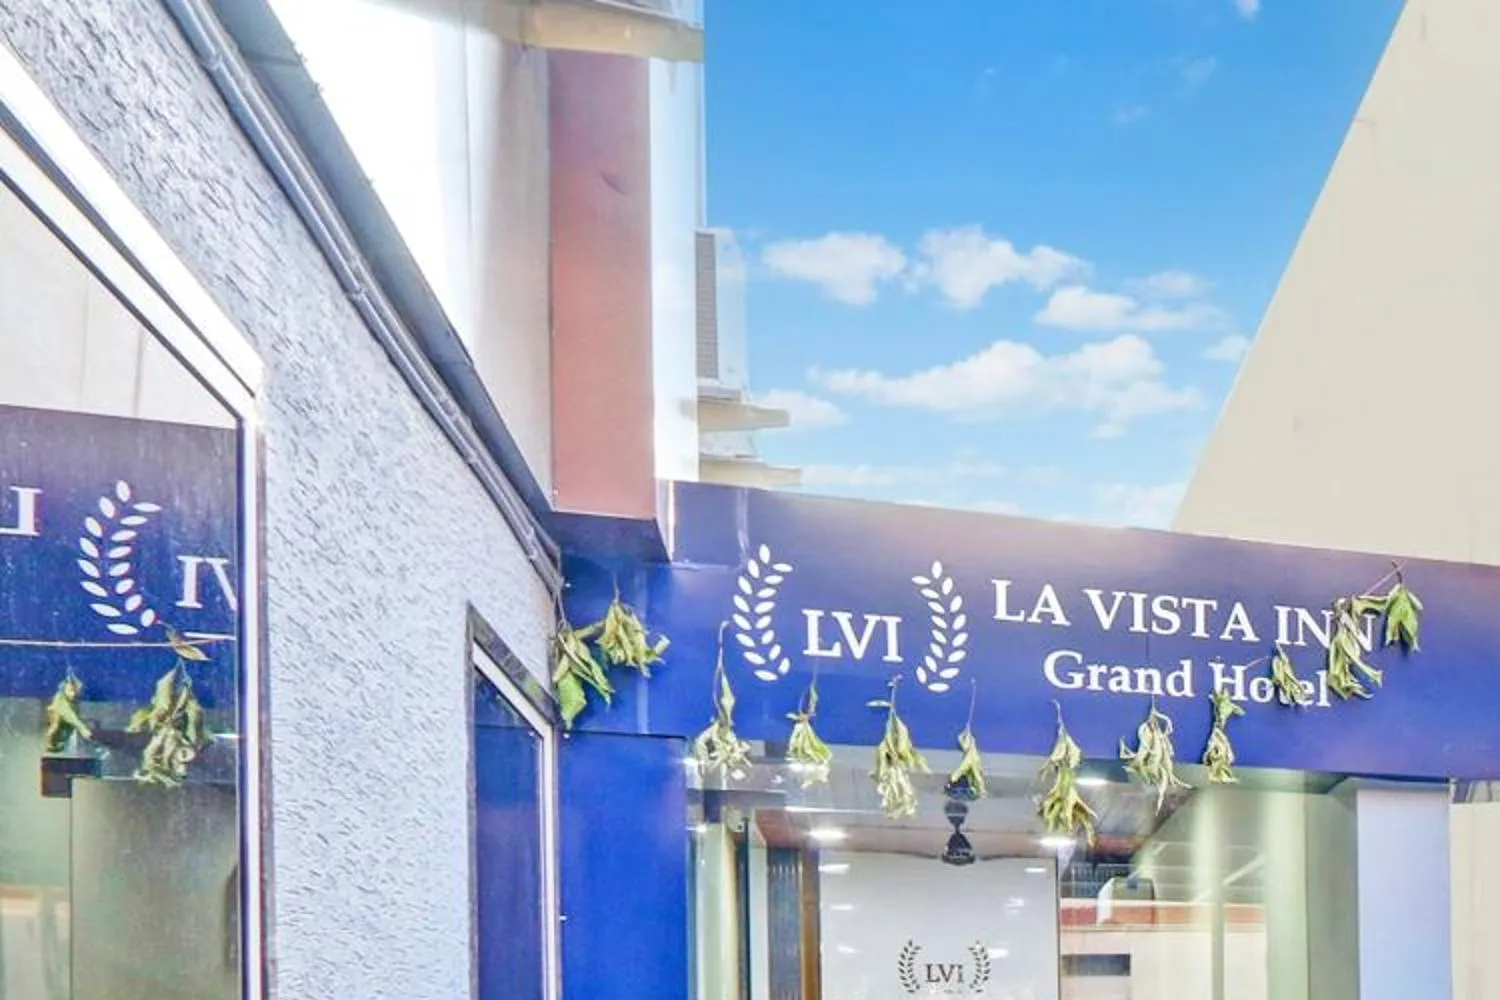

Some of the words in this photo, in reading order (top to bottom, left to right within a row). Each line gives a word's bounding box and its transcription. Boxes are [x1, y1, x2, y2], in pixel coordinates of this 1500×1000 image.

[801, 608, 904, 663] LVI
[991, 579, 1071, 626] LA
[1081, 588, 1260, 642] VISTA
[1273, 605, 1377, 652] INN
[1043, 650, 1195, 698] Grand
